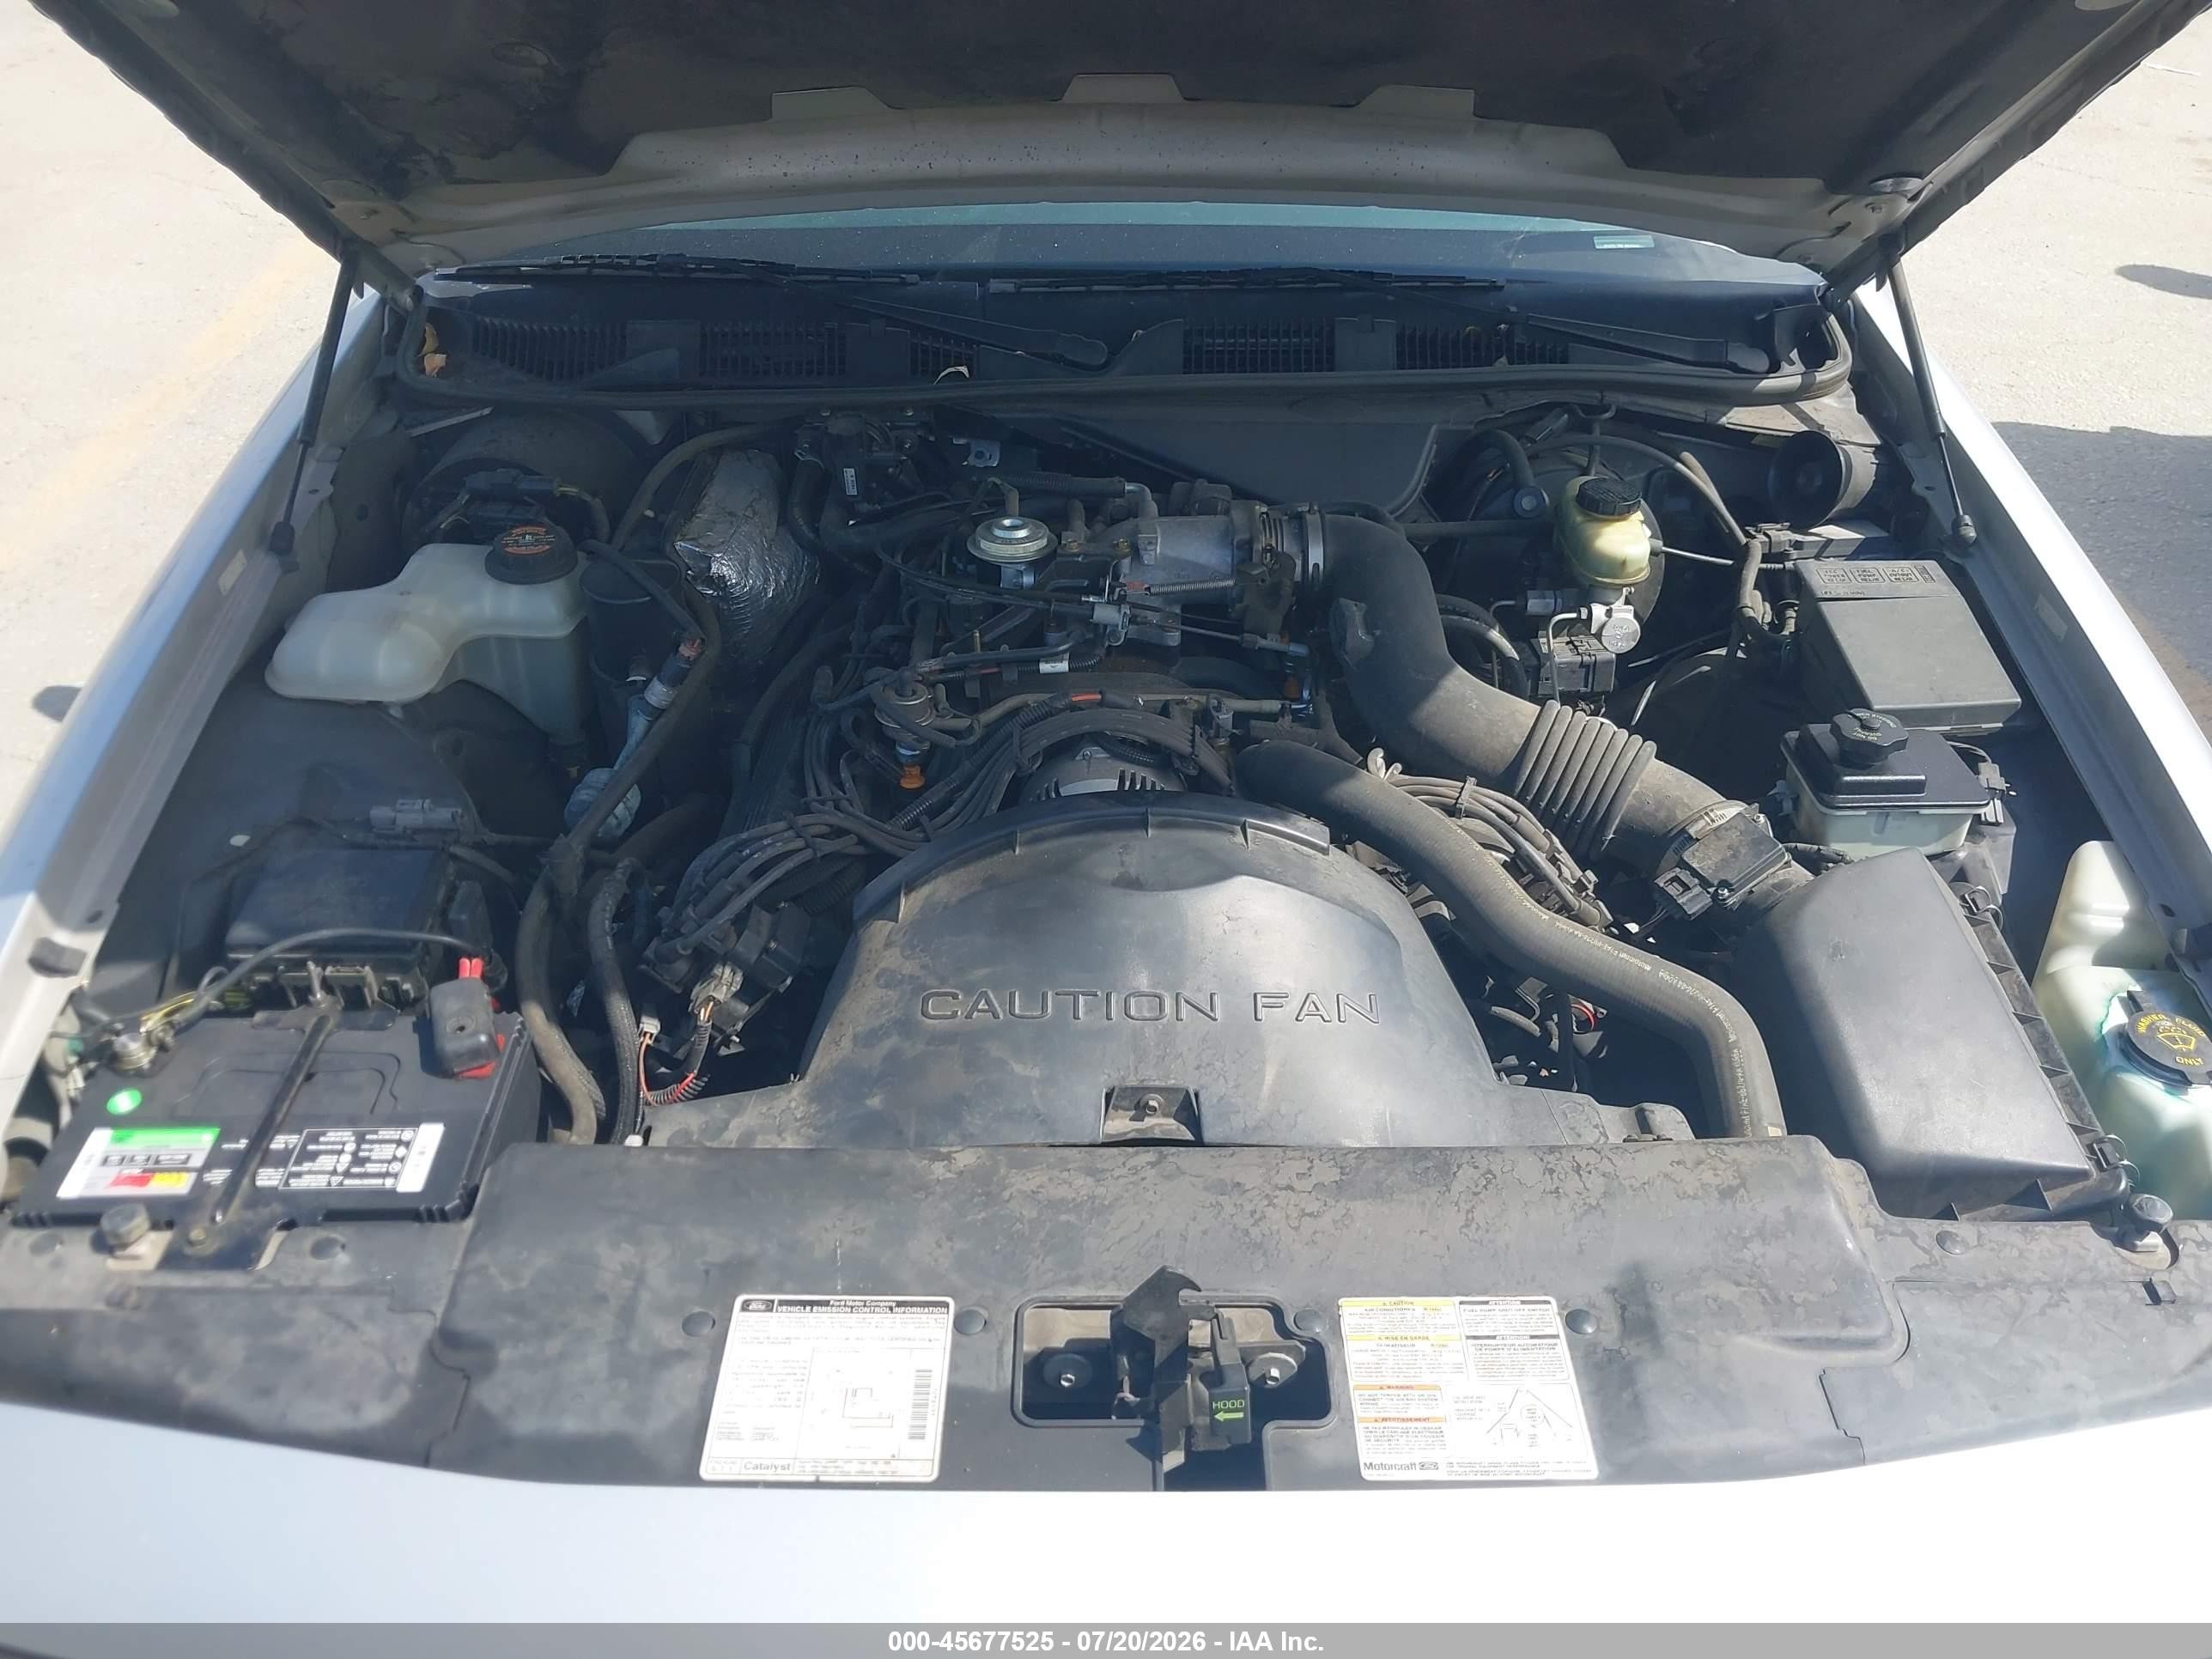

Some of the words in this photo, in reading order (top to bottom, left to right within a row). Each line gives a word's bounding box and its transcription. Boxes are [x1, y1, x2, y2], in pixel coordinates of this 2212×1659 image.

[921, 989, 1219, 1022] CAUTION
[1253, 992, 1380, 1024] FAN
[2175, 1056, 2204, 1066] ONLY
[866, 1299, 896, 1308] Company
[1212, 1399, 1245, 1410] HOOD
[744, 1462, 791, 1472] Catalyst
[1364, 1462, 1417, 1471] Motorcraft
